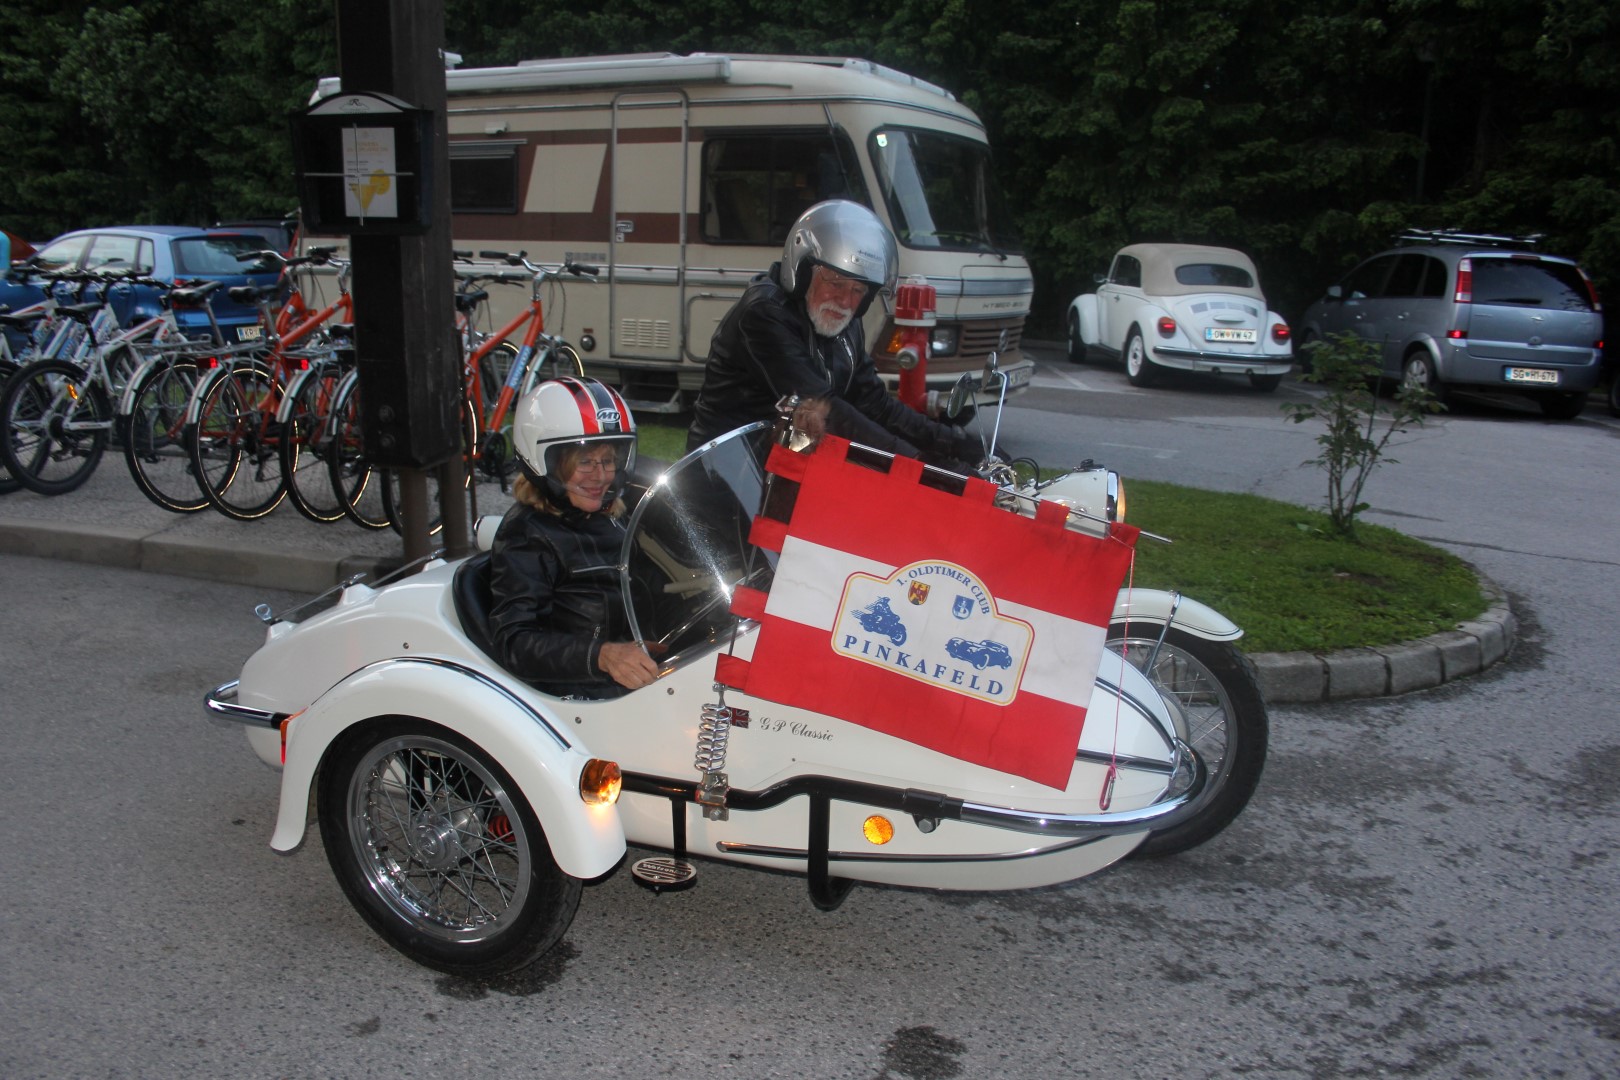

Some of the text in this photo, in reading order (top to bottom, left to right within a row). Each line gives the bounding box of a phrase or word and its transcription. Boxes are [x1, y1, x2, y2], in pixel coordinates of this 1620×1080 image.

[1231, 331, 1242, 339] VW
[1512, 369, 1525, 379] SG
[895, 565, 991, 615] 1. OLDTIMER CLUB
[842, 634, 1004, 696] PINKAFELD
[789, 721, 834, 742] Classic
